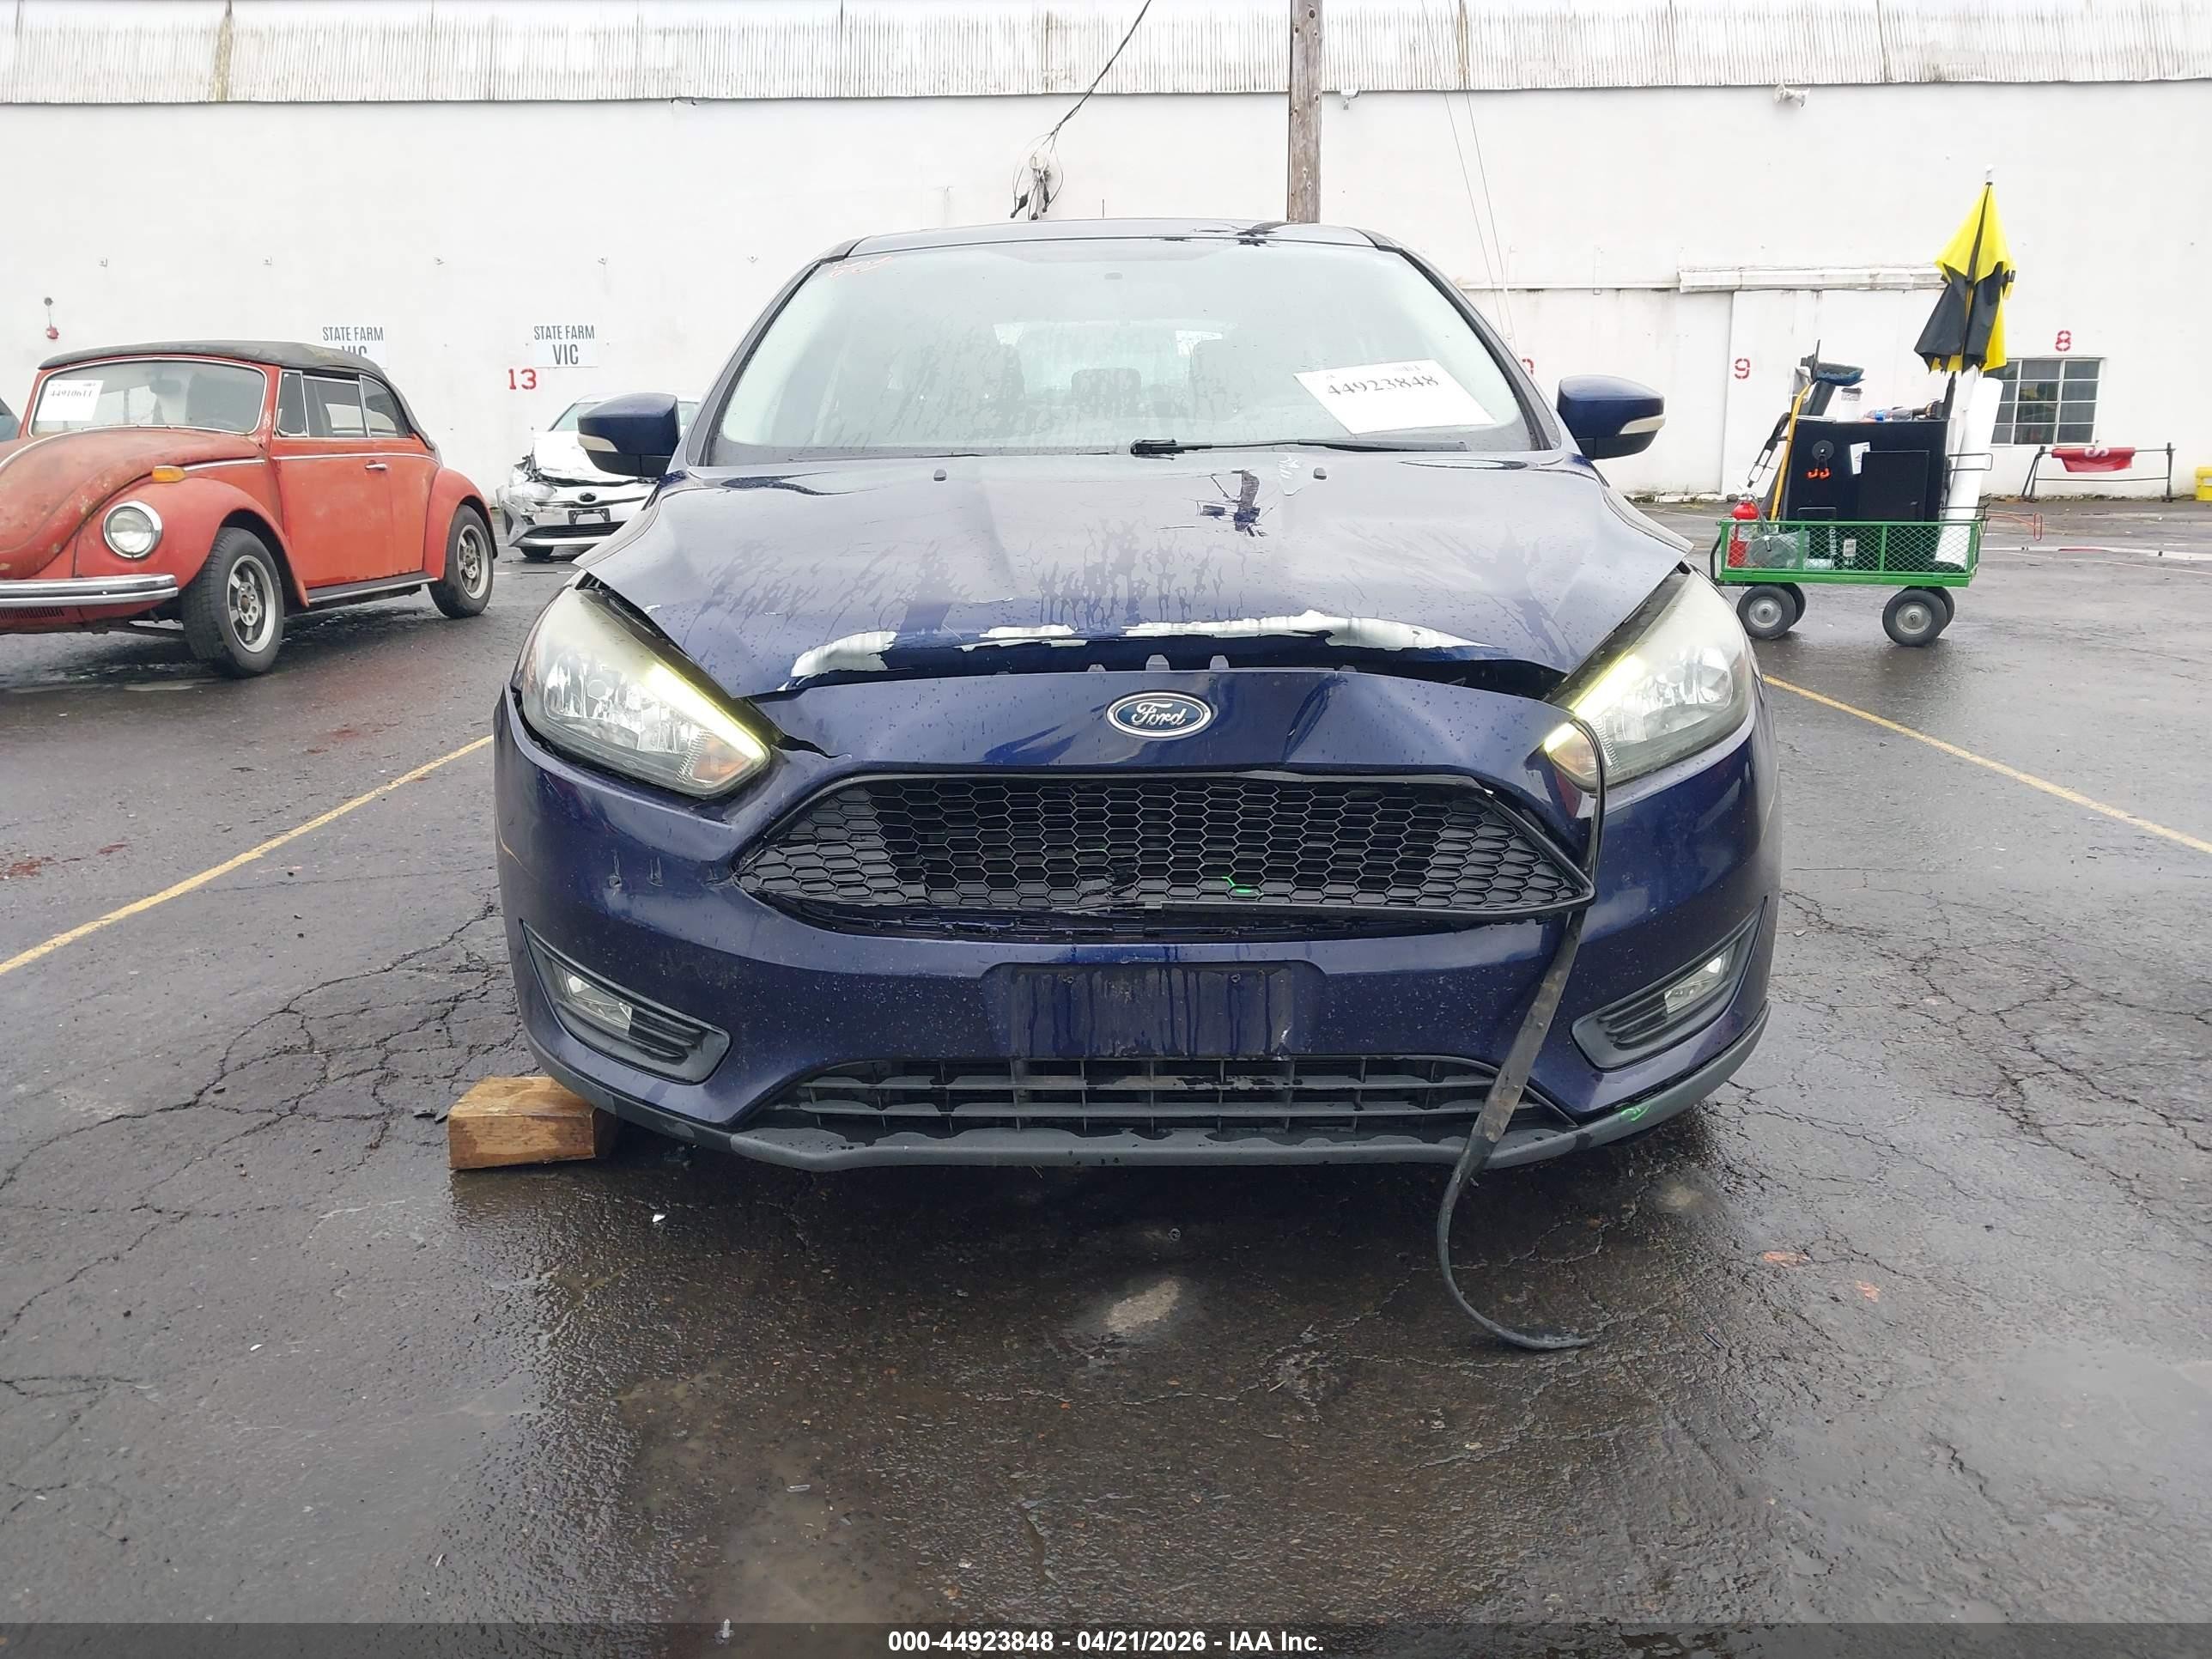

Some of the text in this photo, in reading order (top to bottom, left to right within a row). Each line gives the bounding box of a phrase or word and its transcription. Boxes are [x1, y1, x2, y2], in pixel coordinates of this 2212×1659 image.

[323, 326, 384, 341] STATE FARM
[533, 324, 595, 340] STATE FARM
[2055, 330, 2071, 352] 8
[552, 343, 579, 365] VIC
[508, 368, 537, 390] 13
[1734, 358, 1750, 380] 9
[1328, 374, 1439, 396] 44923848
[1131, 702, 1188, 726] Ford
